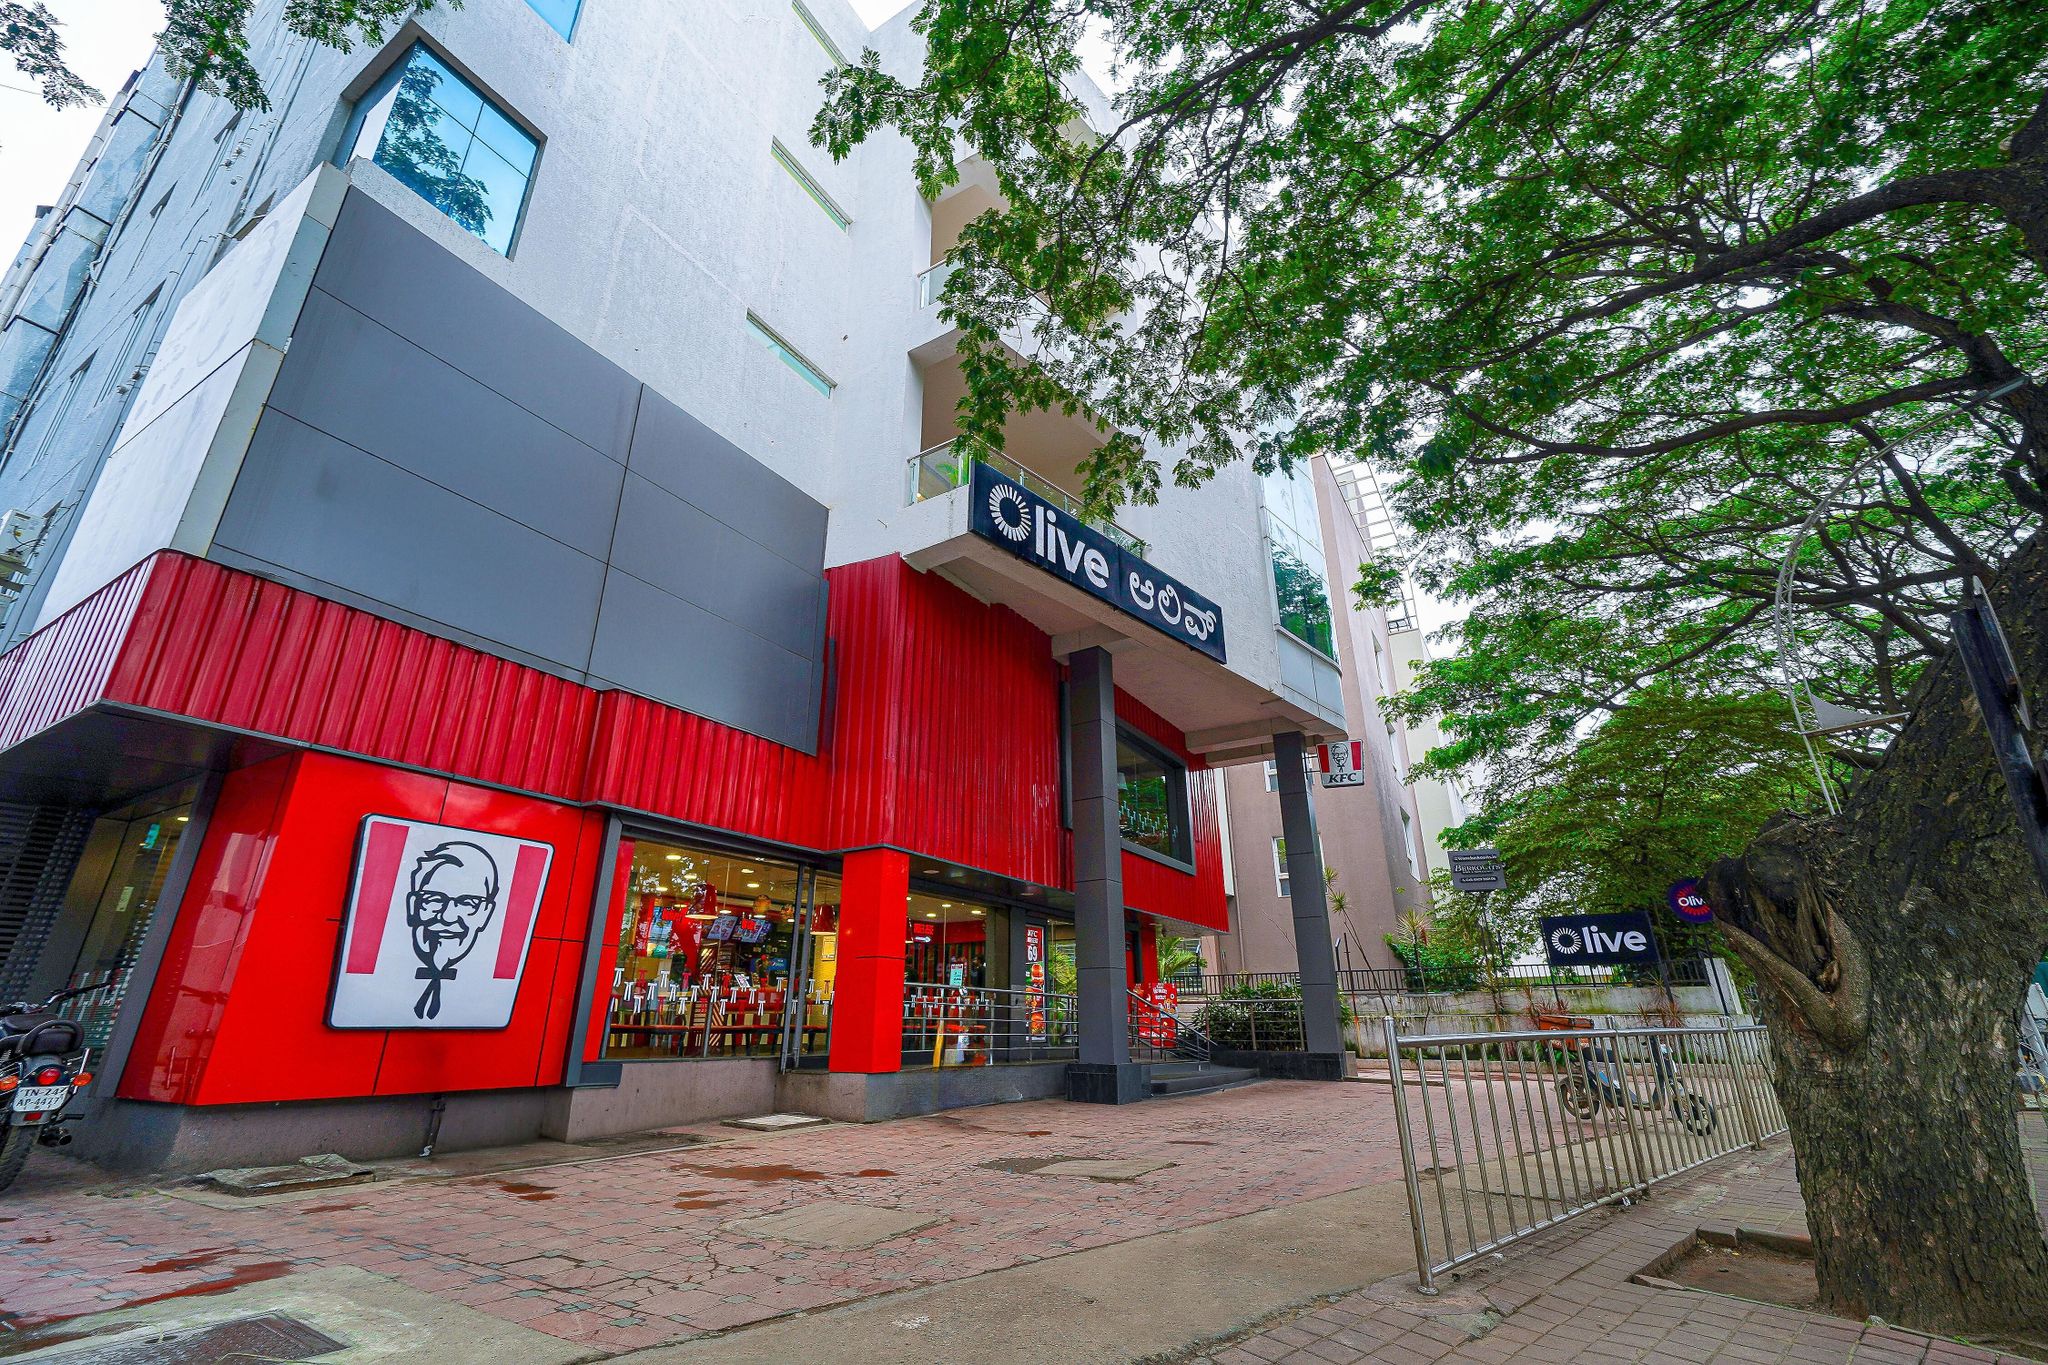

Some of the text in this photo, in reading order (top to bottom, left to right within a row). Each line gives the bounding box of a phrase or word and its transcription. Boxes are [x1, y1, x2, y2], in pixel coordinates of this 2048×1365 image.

[1328, 773, 1357, 784] KFC
[1678, 895, 1706, 907] Oliv
[1551, 925, 1646, 954] Olive
